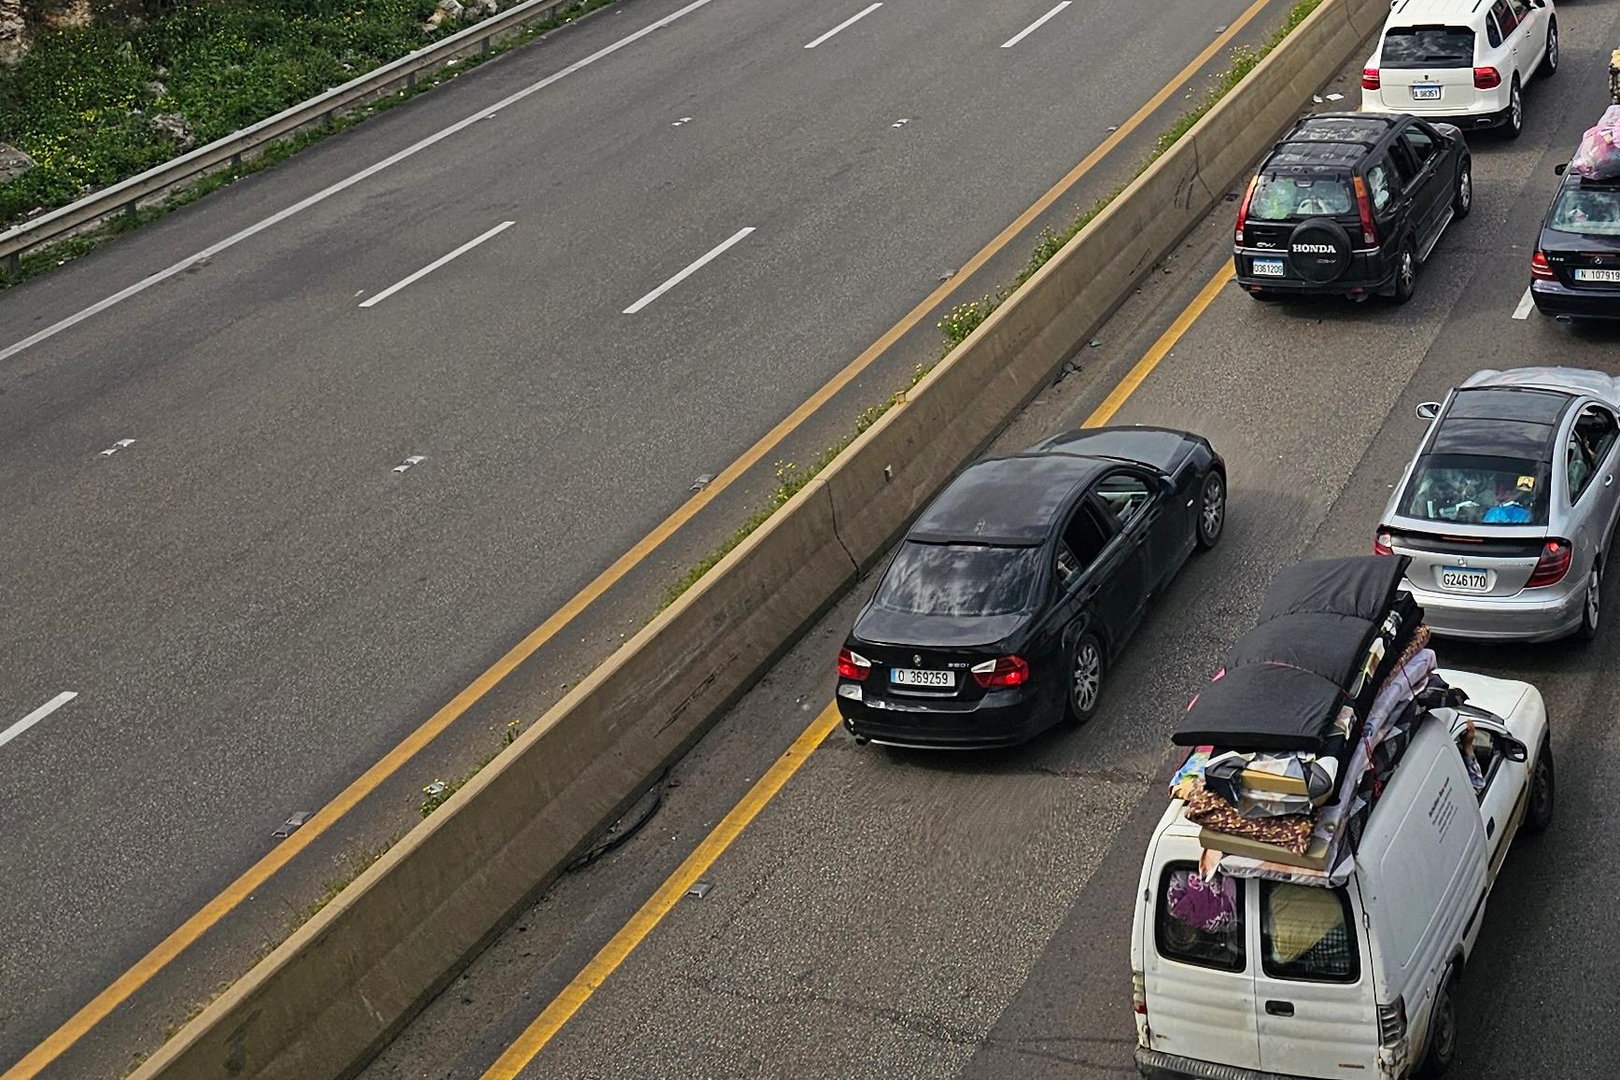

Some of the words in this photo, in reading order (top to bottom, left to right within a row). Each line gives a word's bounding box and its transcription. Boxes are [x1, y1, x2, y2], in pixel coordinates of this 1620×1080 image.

[1292, 243, 1337, 254] HONDA
[1591, 271, 1620, 280] 107919
[1443, 573, 1486, 588] G246170
[911, 671, 949, 684] 369259
